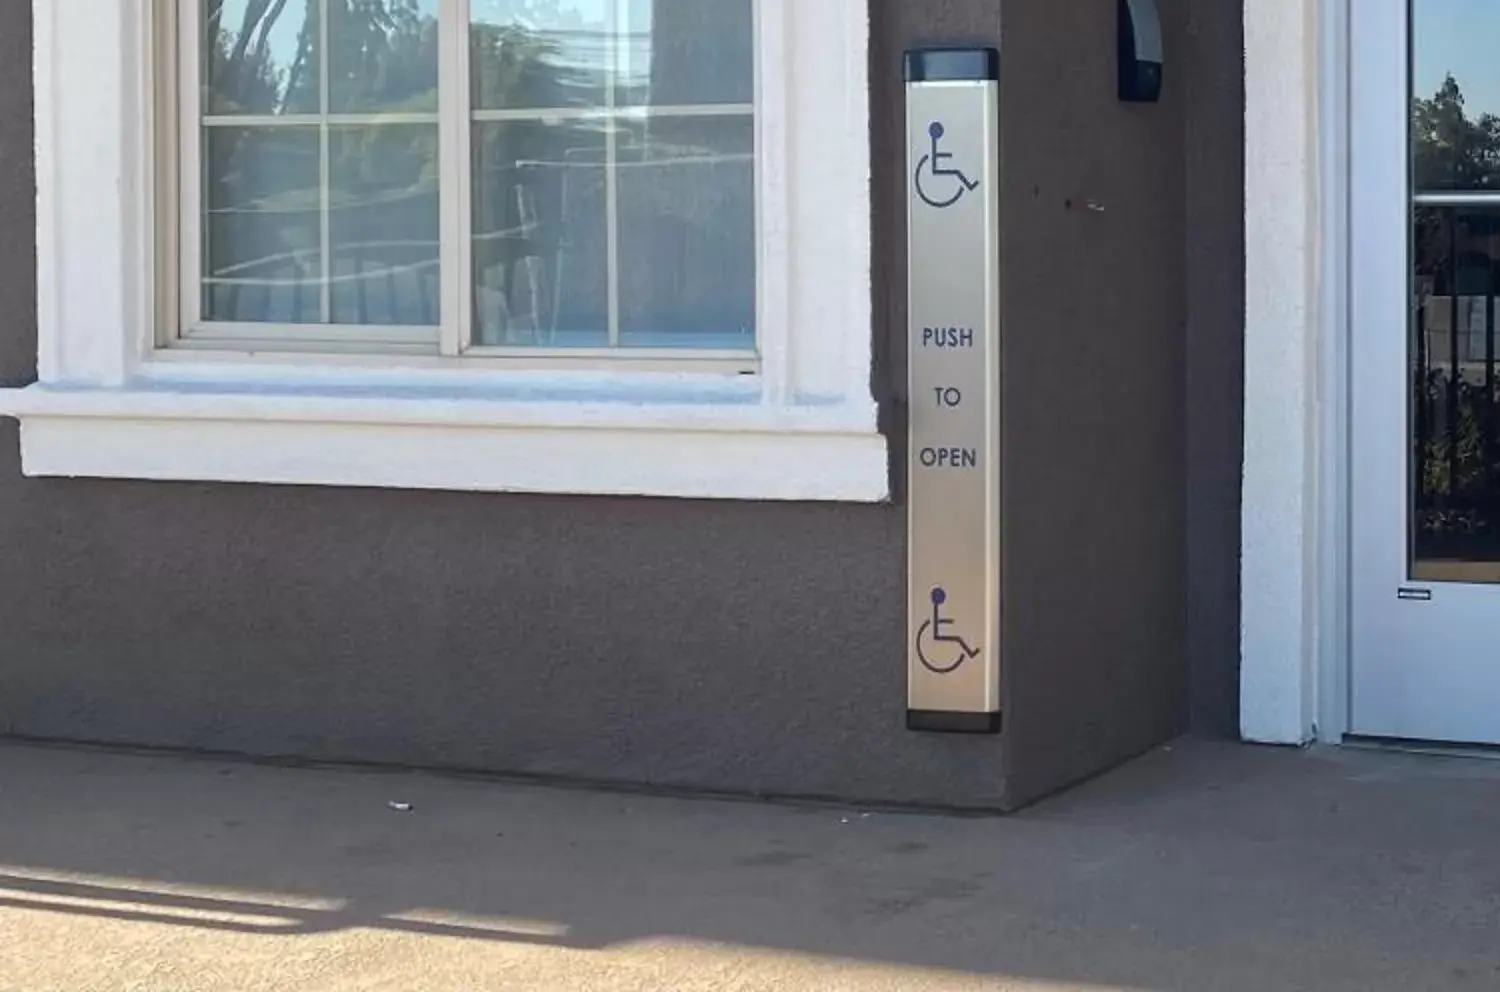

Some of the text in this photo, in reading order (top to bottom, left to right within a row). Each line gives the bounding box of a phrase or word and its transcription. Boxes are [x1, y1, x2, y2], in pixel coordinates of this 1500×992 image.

[922, 327, 973, 347] PUSH
[934, 387, 961, 406] TO
[920, 447, 976, 467] OPEN
